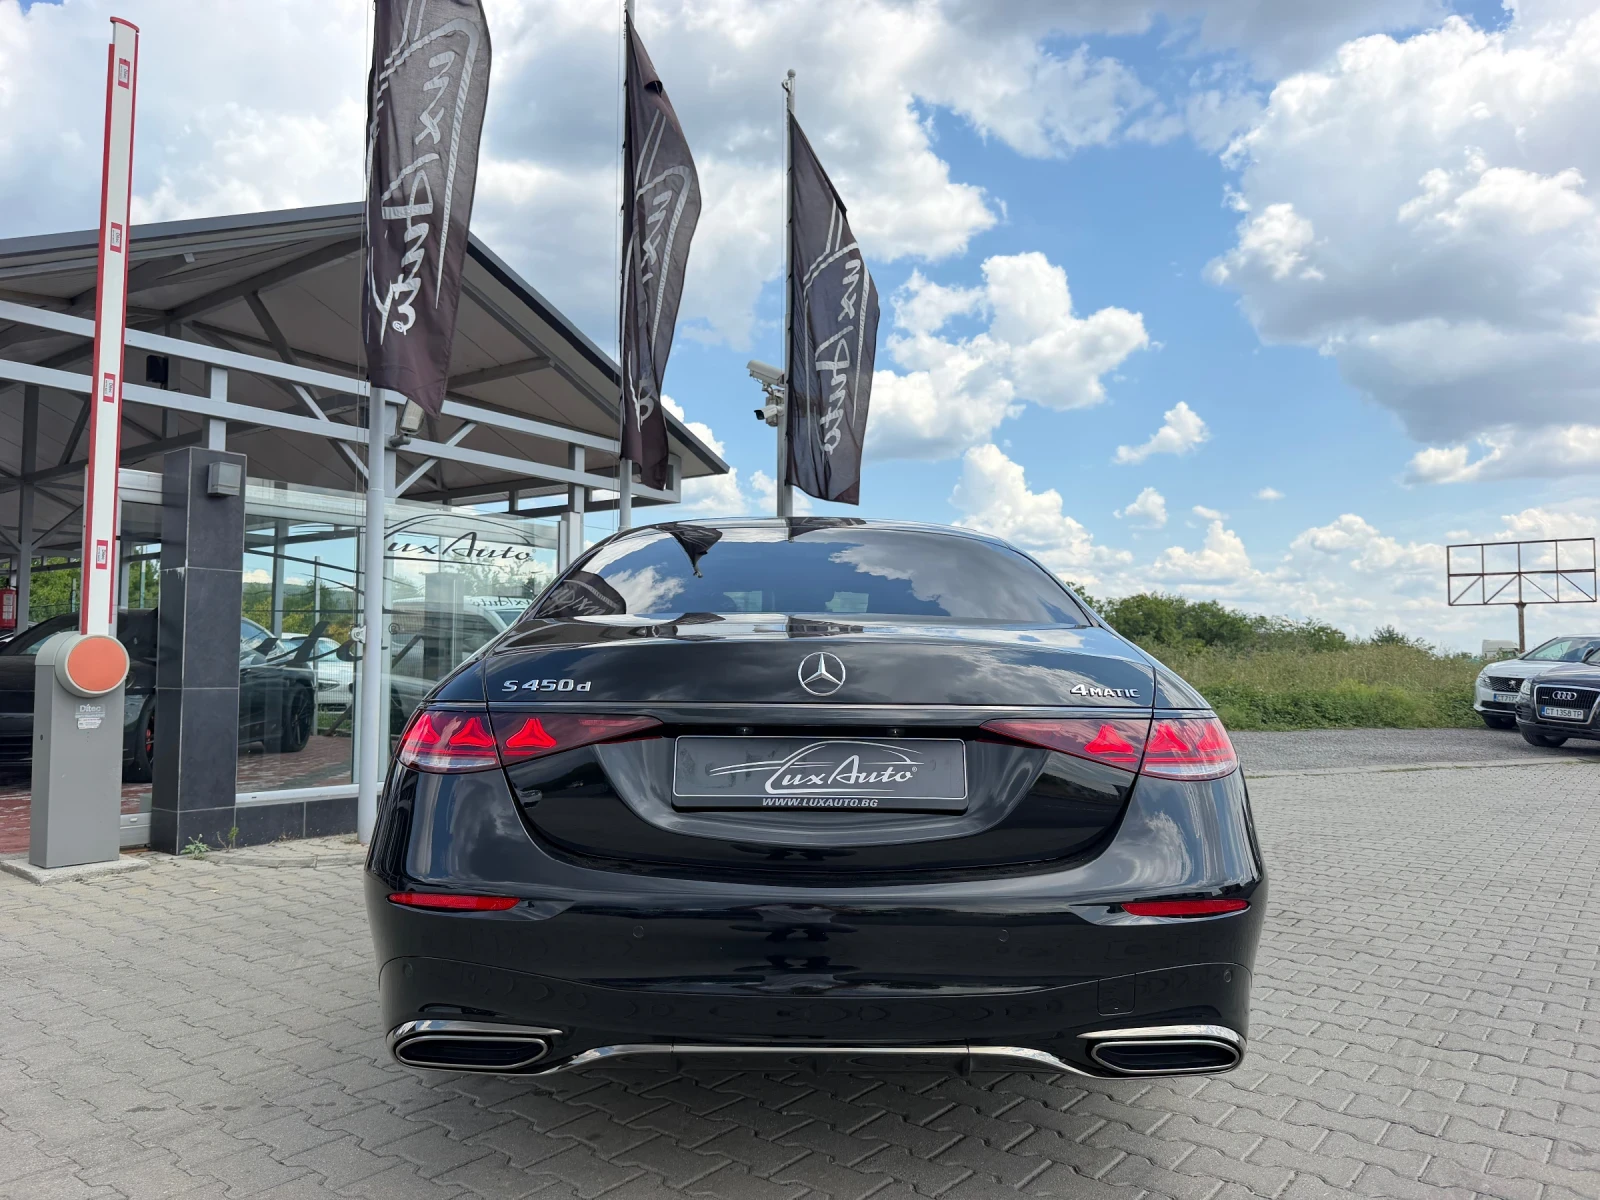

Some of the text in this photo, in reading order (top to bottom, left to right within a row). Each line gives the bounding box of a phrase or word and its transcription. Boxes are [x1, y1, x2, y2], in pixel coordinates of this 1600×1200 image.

[501, 680, 519, 691] S
[1070, 684, 1141, 698] 4MATIC
[1545, 707, 1583, 718] CT 1358 TP
[762, 797, 878, 808] WWW.LUXAUTO.BG
